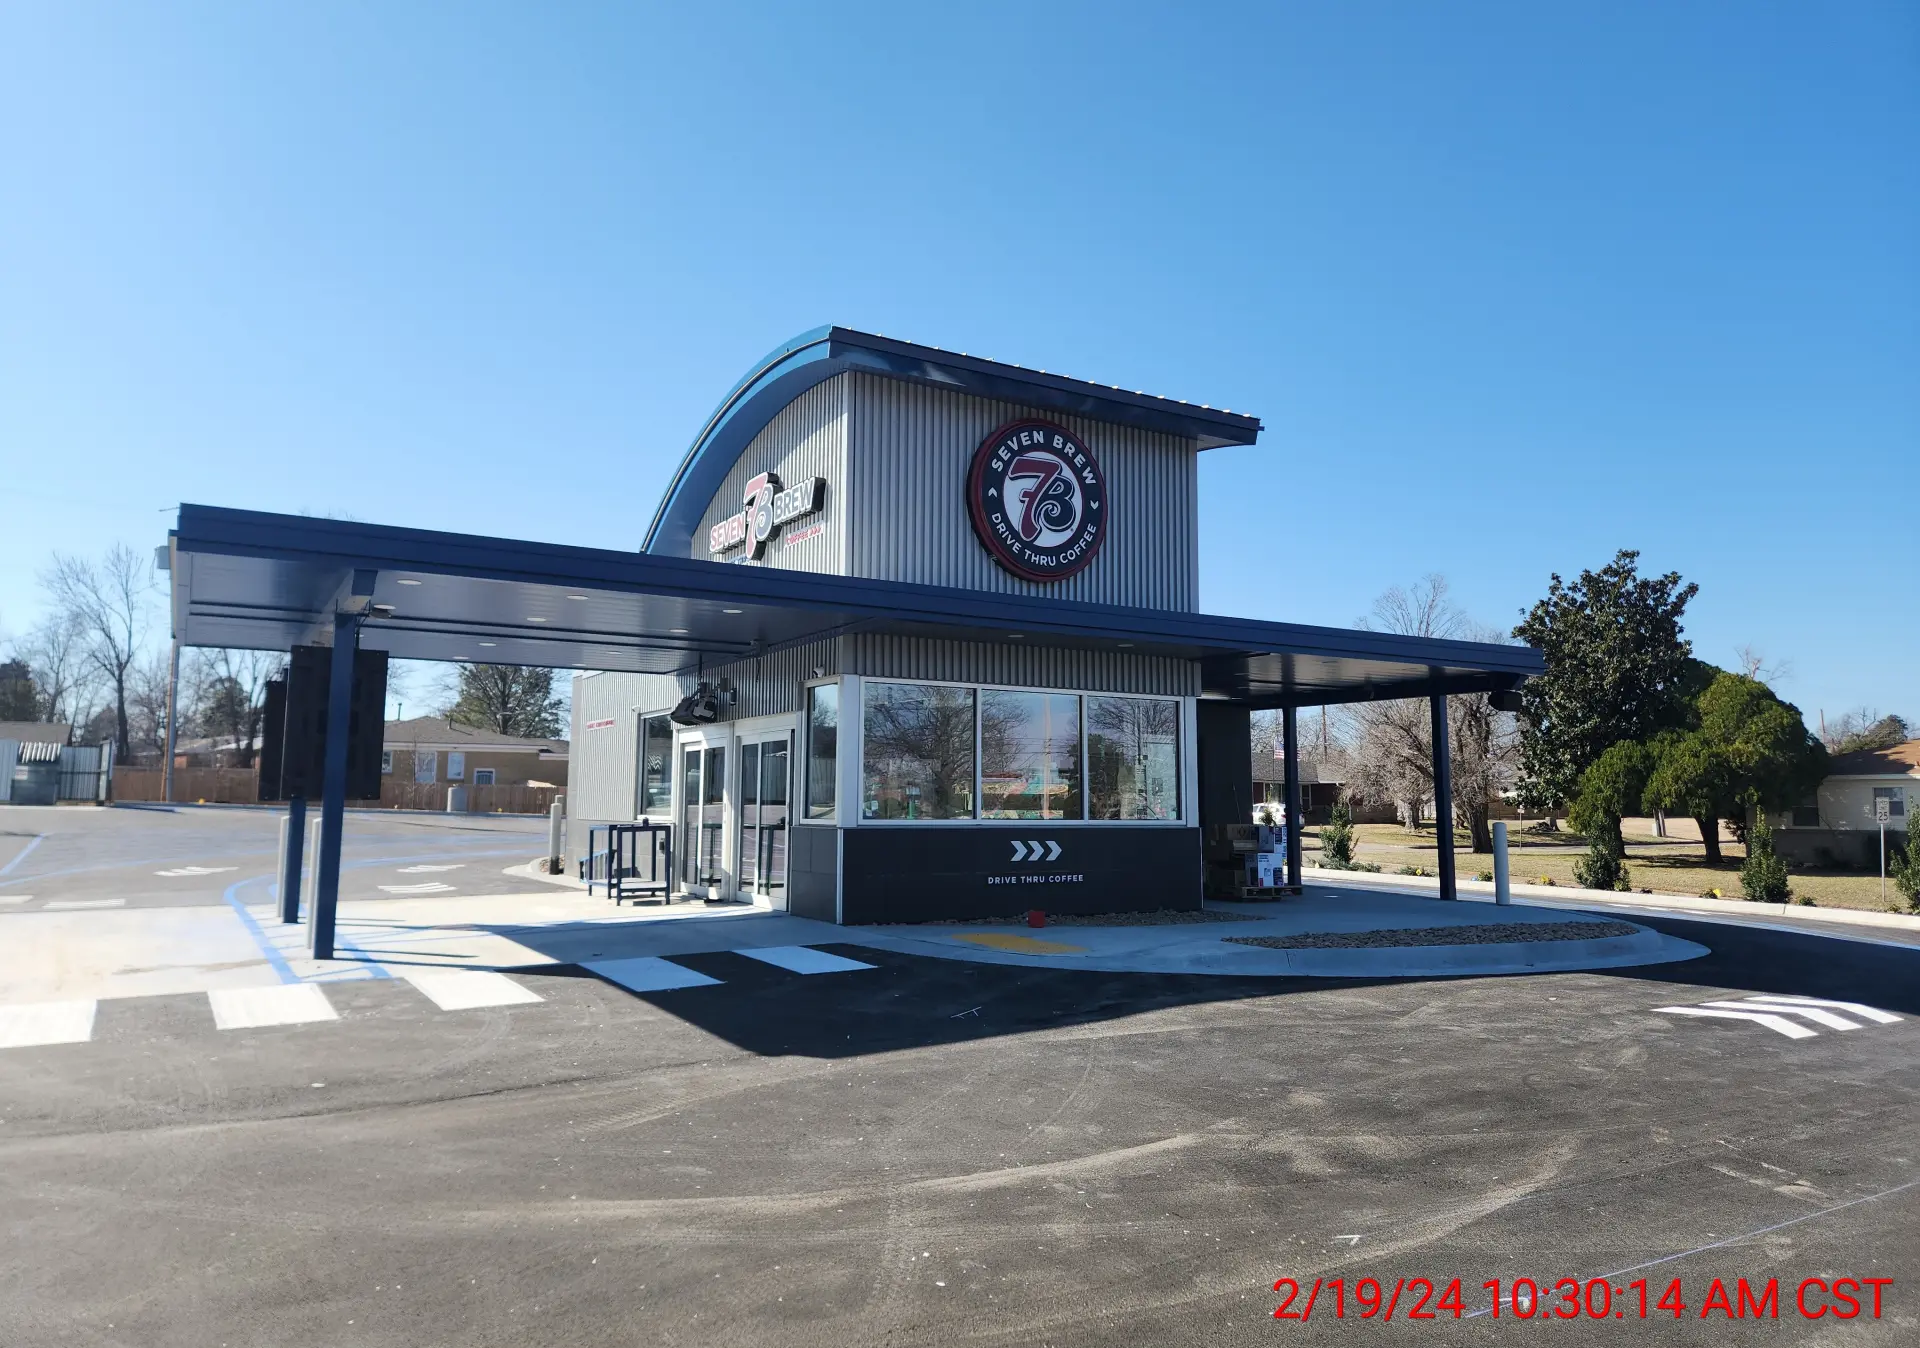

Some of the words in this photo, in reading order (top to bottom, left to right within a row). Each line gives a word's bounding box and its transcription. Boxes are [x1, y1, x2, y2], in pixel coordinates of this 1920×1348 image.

[991, 430, 1044, 472] SEVEN
[1052, 434, 1097, 485] BREW
[710, 510, 746, 552] SEVEN
[773, 477, 815, 525] BREW
[991, 512, 1024, 554] DRIVE
[1024, 549, 1056, 567] THRU
[1060, 523, 1097, 564] COFFEE
[1878, 811, 1888, 821] 25
[987, 876, 1017, 884] DRIVE
[1020, 875, 1045, 884] THRU
[1048, 874, 1084, 883] COFFEE
